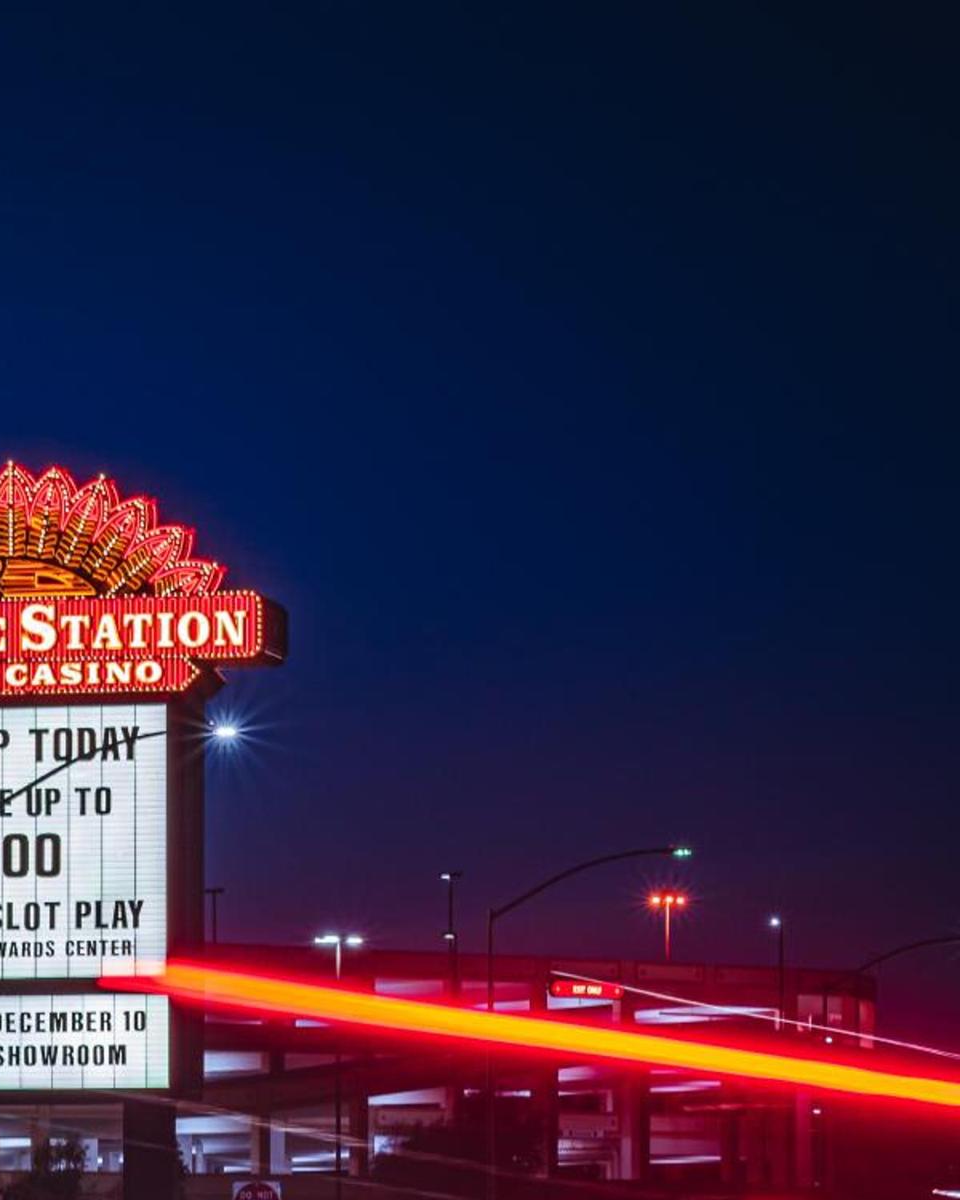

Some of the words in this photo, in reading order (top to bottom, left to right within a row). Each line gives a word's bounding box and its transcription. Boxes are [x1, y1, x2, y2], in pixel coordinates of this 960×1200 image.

[20, 603, 247, 651] STATION
[5, 660, 163, 686] CASINO
[29, 726, 140, 763] TODAY
[26, 787, 61, 817] UP
[75, 786, 112, 816] TO
[75, 900, 144, 930] PLAY
[65, 939, 132, 957] CENTER
[123, 1010, 146, 1032] 10
